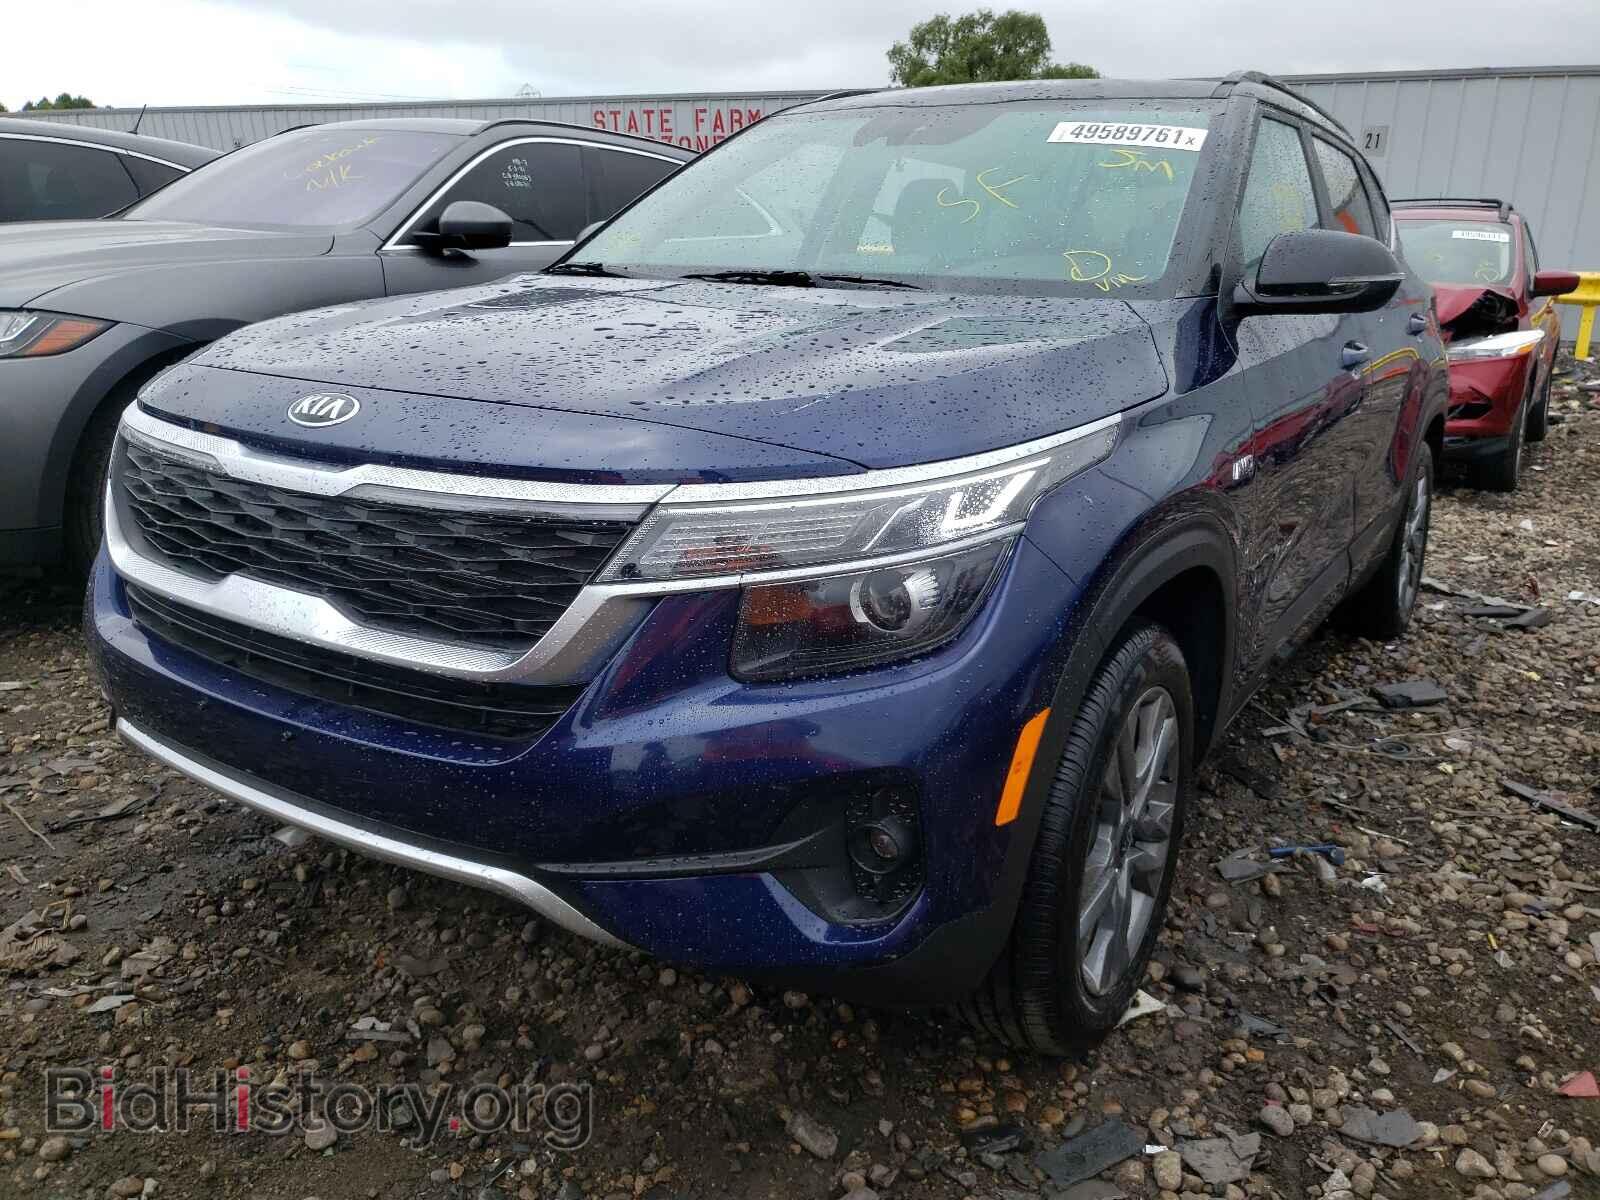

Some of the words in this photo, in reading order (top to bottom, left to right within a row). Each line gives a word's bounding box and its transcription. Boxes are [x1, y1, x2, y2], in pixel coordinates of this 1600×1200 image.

[593, 109, 673, 133] STATE
[695, 108, 761, 133] FARM
[1070, 124, 1184, 145] 49589761
[1364, 132, 1381, 150] 21
[294, 394, 346, 419] KIA
